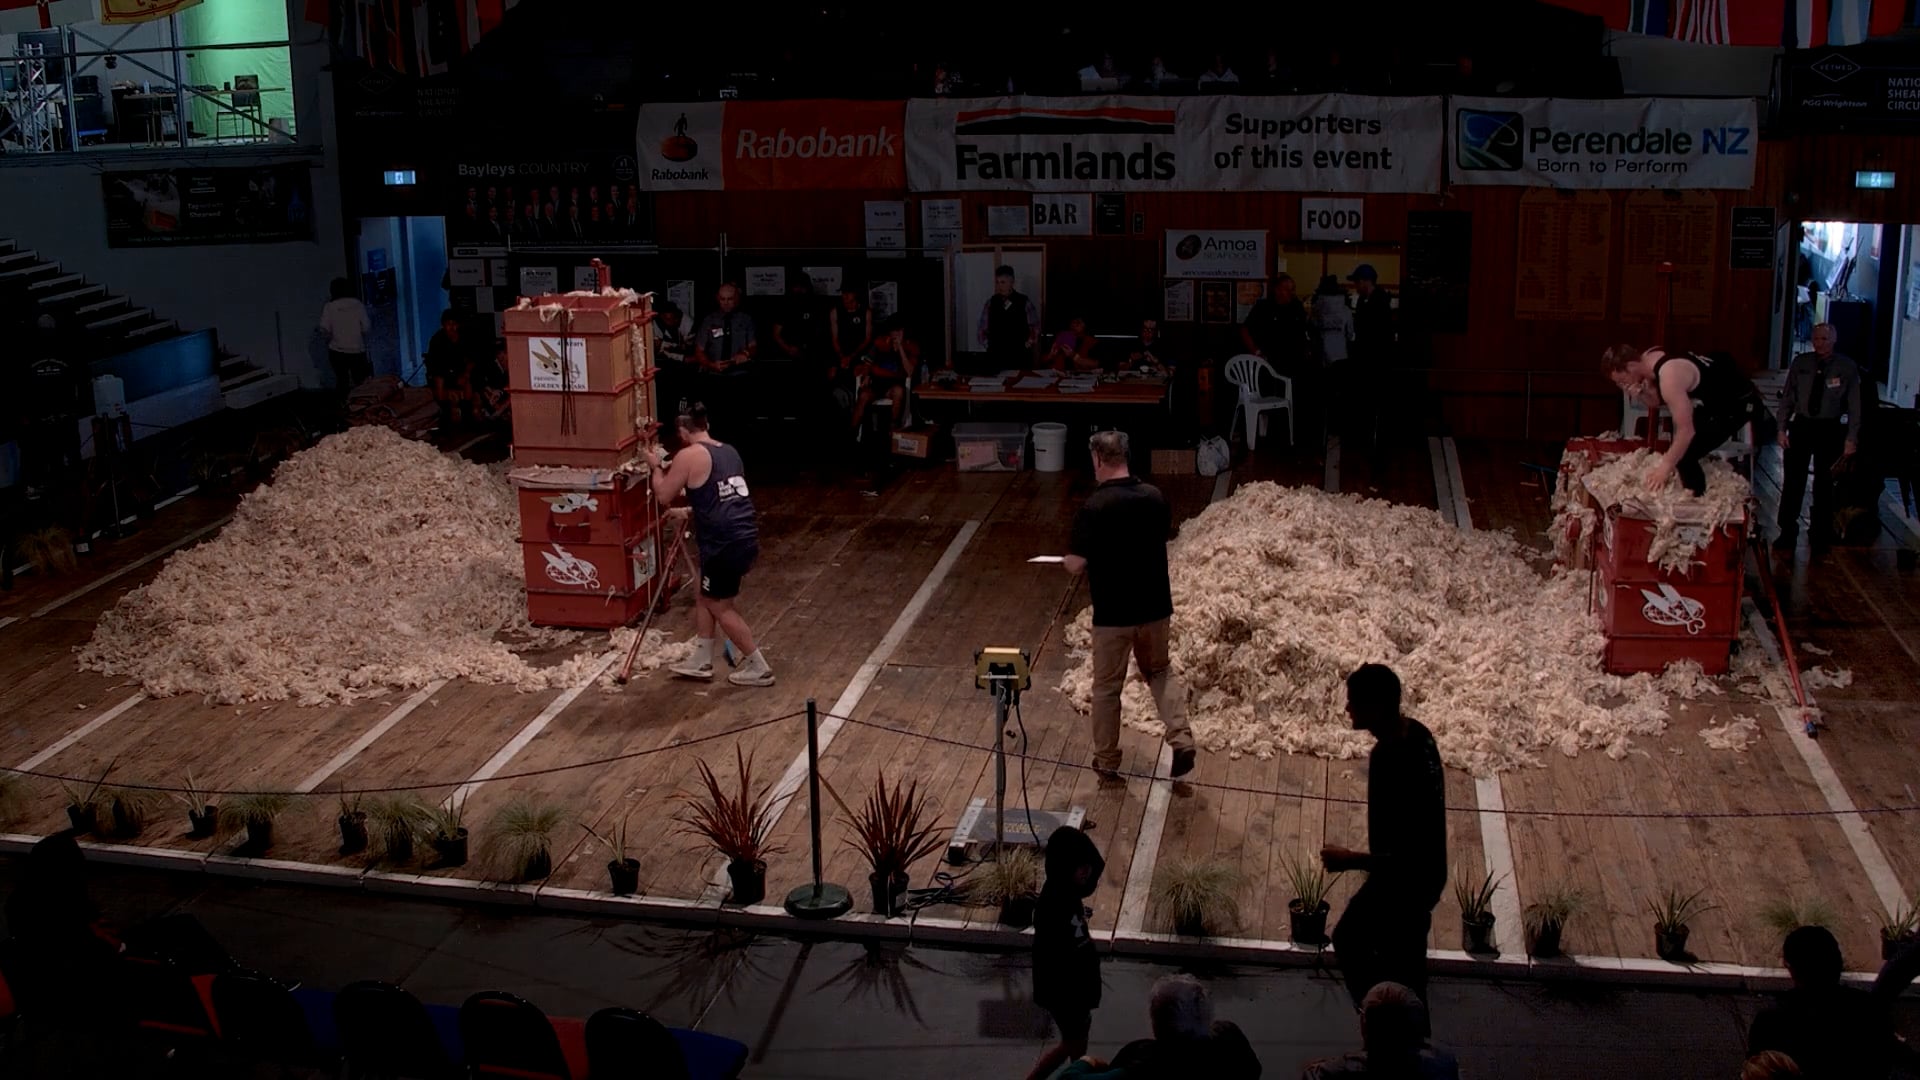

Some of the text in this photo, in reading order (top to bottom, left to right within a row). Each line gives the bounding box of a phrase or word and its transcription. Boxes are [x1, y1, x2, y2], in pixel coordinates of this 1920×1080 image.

[1823, 99, 1868, 108] Wrightson
[1888, 89, 1920, 99] SHEA
[1225, 113, 1381, 139] Supporters
[736, 126, 897, 160] Rabobank
[1529, 127, 1750, 155] Perendale NZ
[955, 142, 1176, 180] Farmlands
[1214, 144, 1392, 170] of this event
[1537, 158, 1688, 174] Born to Perform
[457, 162, 591, 178] Bayleys COUNTRY
[651, 168, 709, 181] Rabobank
[1034, 203, 1077, 225] BAR
[1306, 210, 1361, 229] FOOD
[1204, 236, 1257, 251] Amoa
